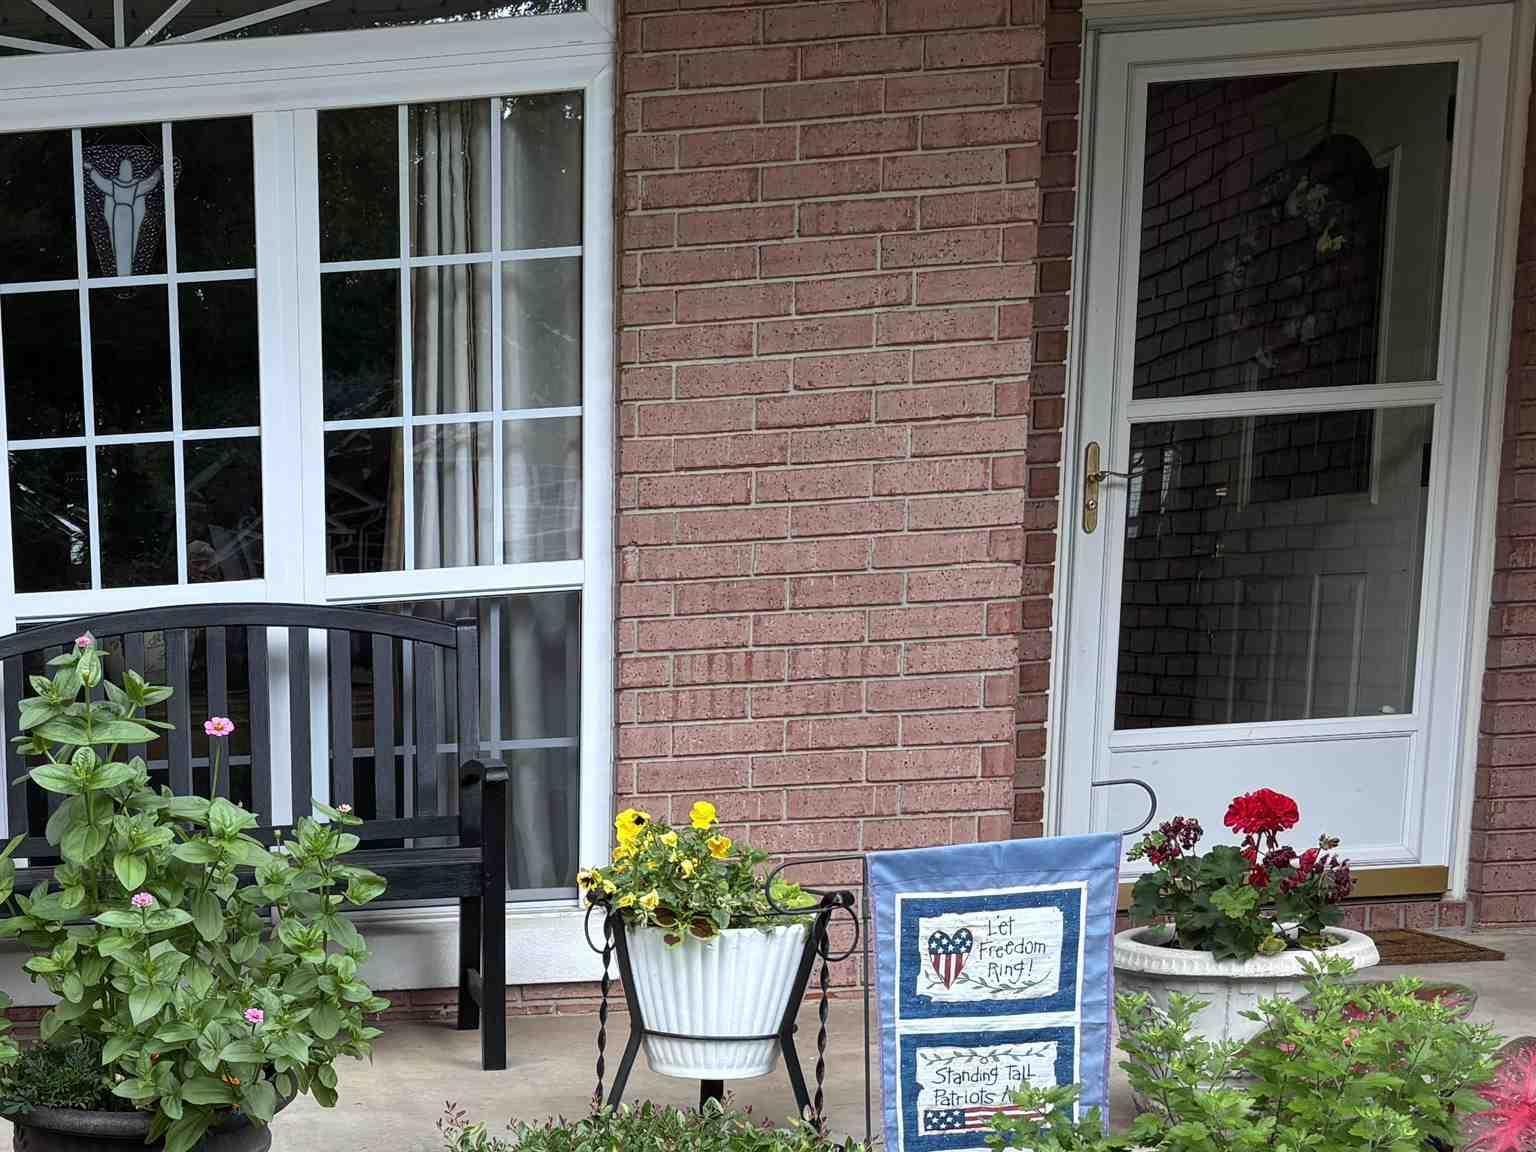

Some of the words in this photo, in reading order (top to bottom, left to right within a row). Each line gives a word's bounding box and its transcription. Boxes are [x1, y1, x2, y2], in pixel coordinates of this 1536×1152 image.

[988, 916, 1016, 936] Let
[979, 937, 1046, 960] Freedom
[988, 958, 1033, 984] Ring!
[930, 1064, 998, 1086] Standing
[933, 1087, 996, 1106] Patriots
